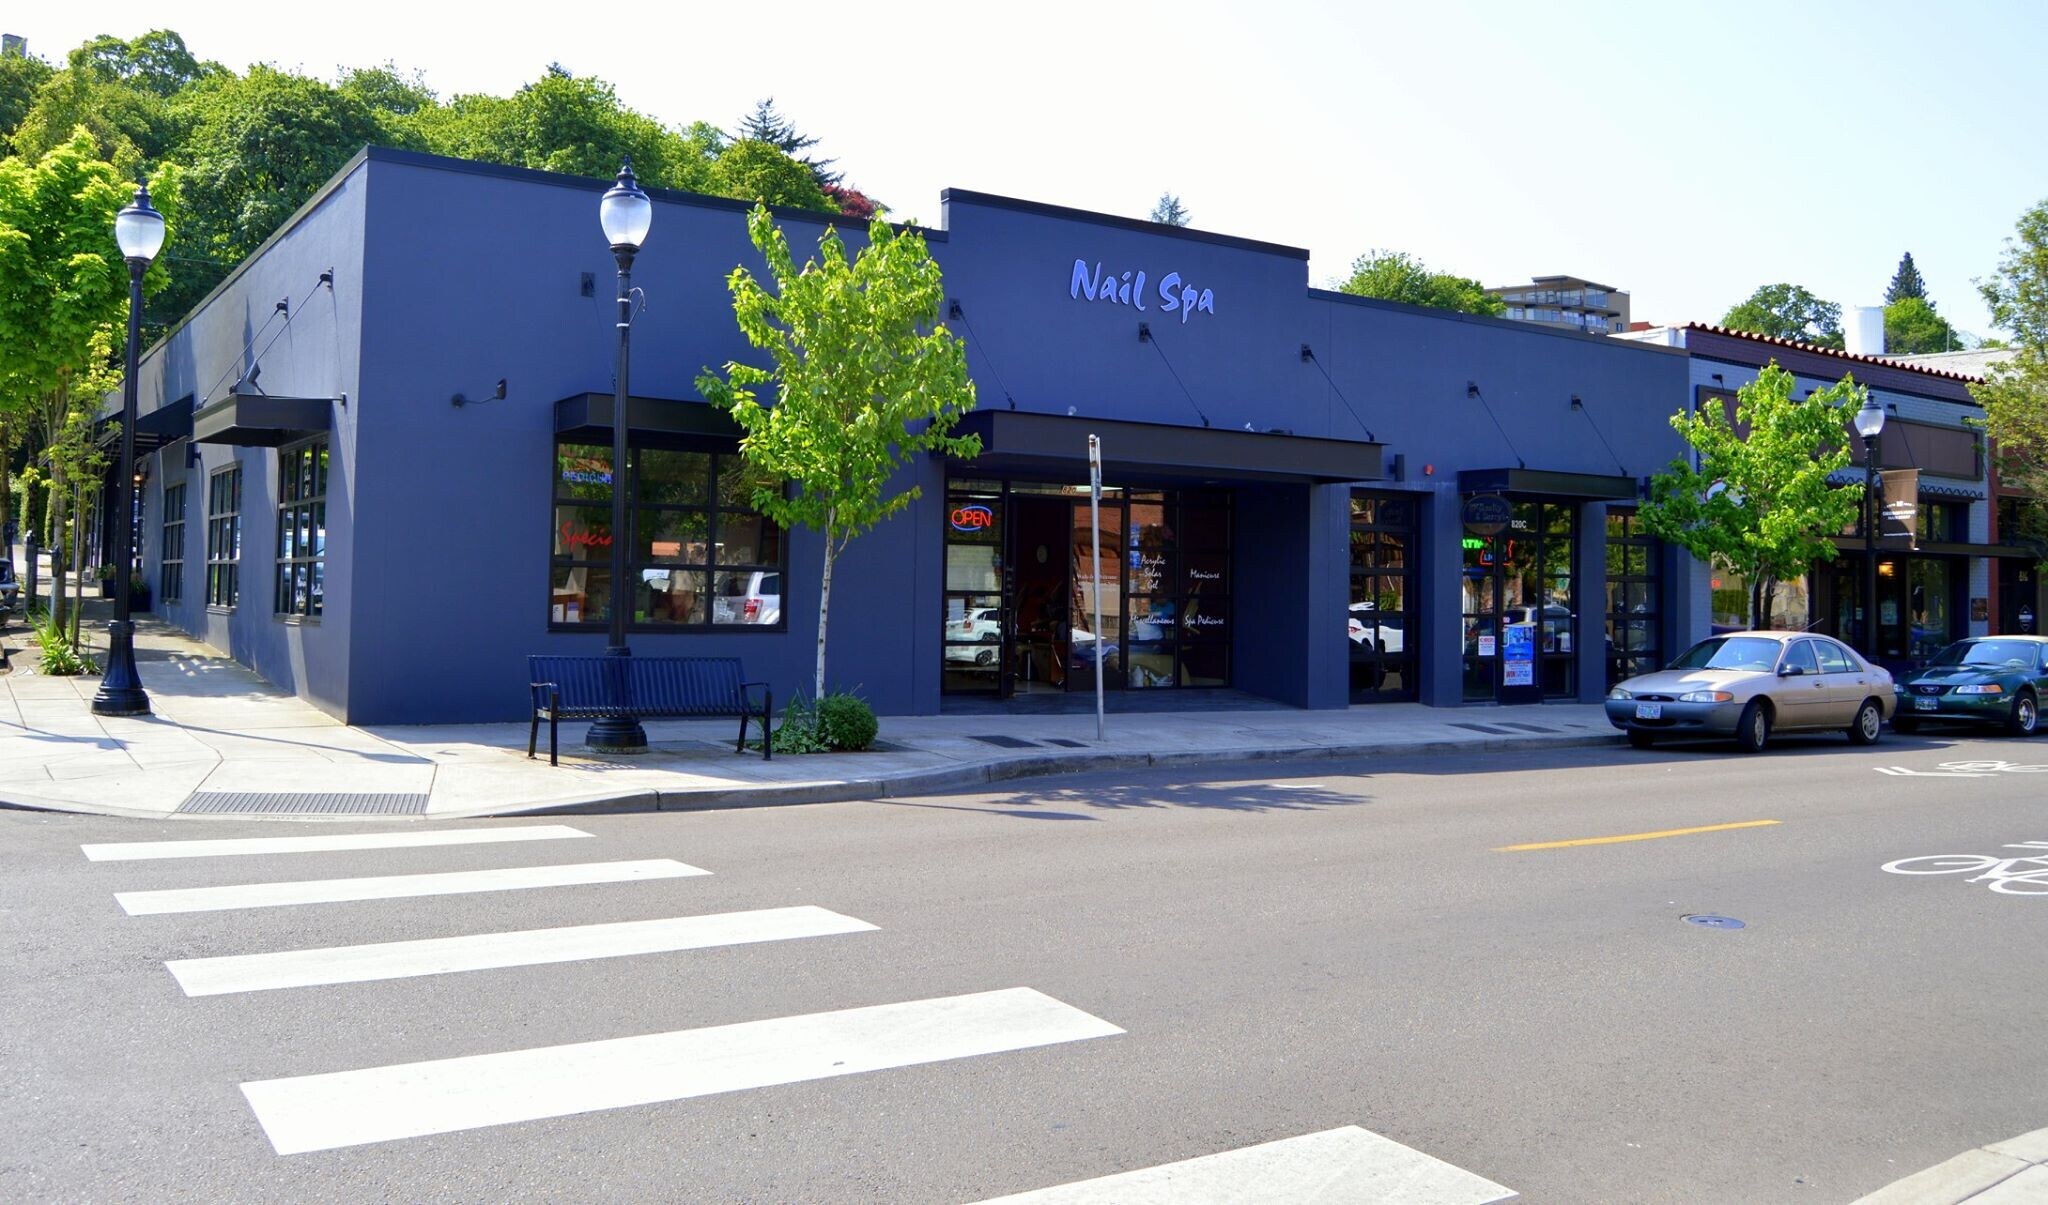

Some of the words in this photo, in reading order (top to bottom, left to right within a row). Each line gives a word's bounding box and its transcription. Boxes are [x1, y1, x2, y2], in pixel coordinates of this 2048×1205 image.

[1070, 258, 1146, 312] Nail
[1158, 271, 1214, 325] Spa
[562, 471, 613, 484] PEDICUR
[1061, 485, 1077, 495] 820
[951, 508, 992, 528] OPEN
[1511, 519, 1527, 529] 820C
[560, 519, 613, 552] Specia
[1140, 554, 1166, 568] Acrylic
[1143, 567, 1162, 578] Solar
[1190, 568, 1220, 579] Manicure
[1147, 579, 1159, 590] Gel
[1130, 614, 1175, 625] Miscellaneous
[1185, 614, 1196, 627] Spa
[1197, 614, 1224, 625] Pedicure
